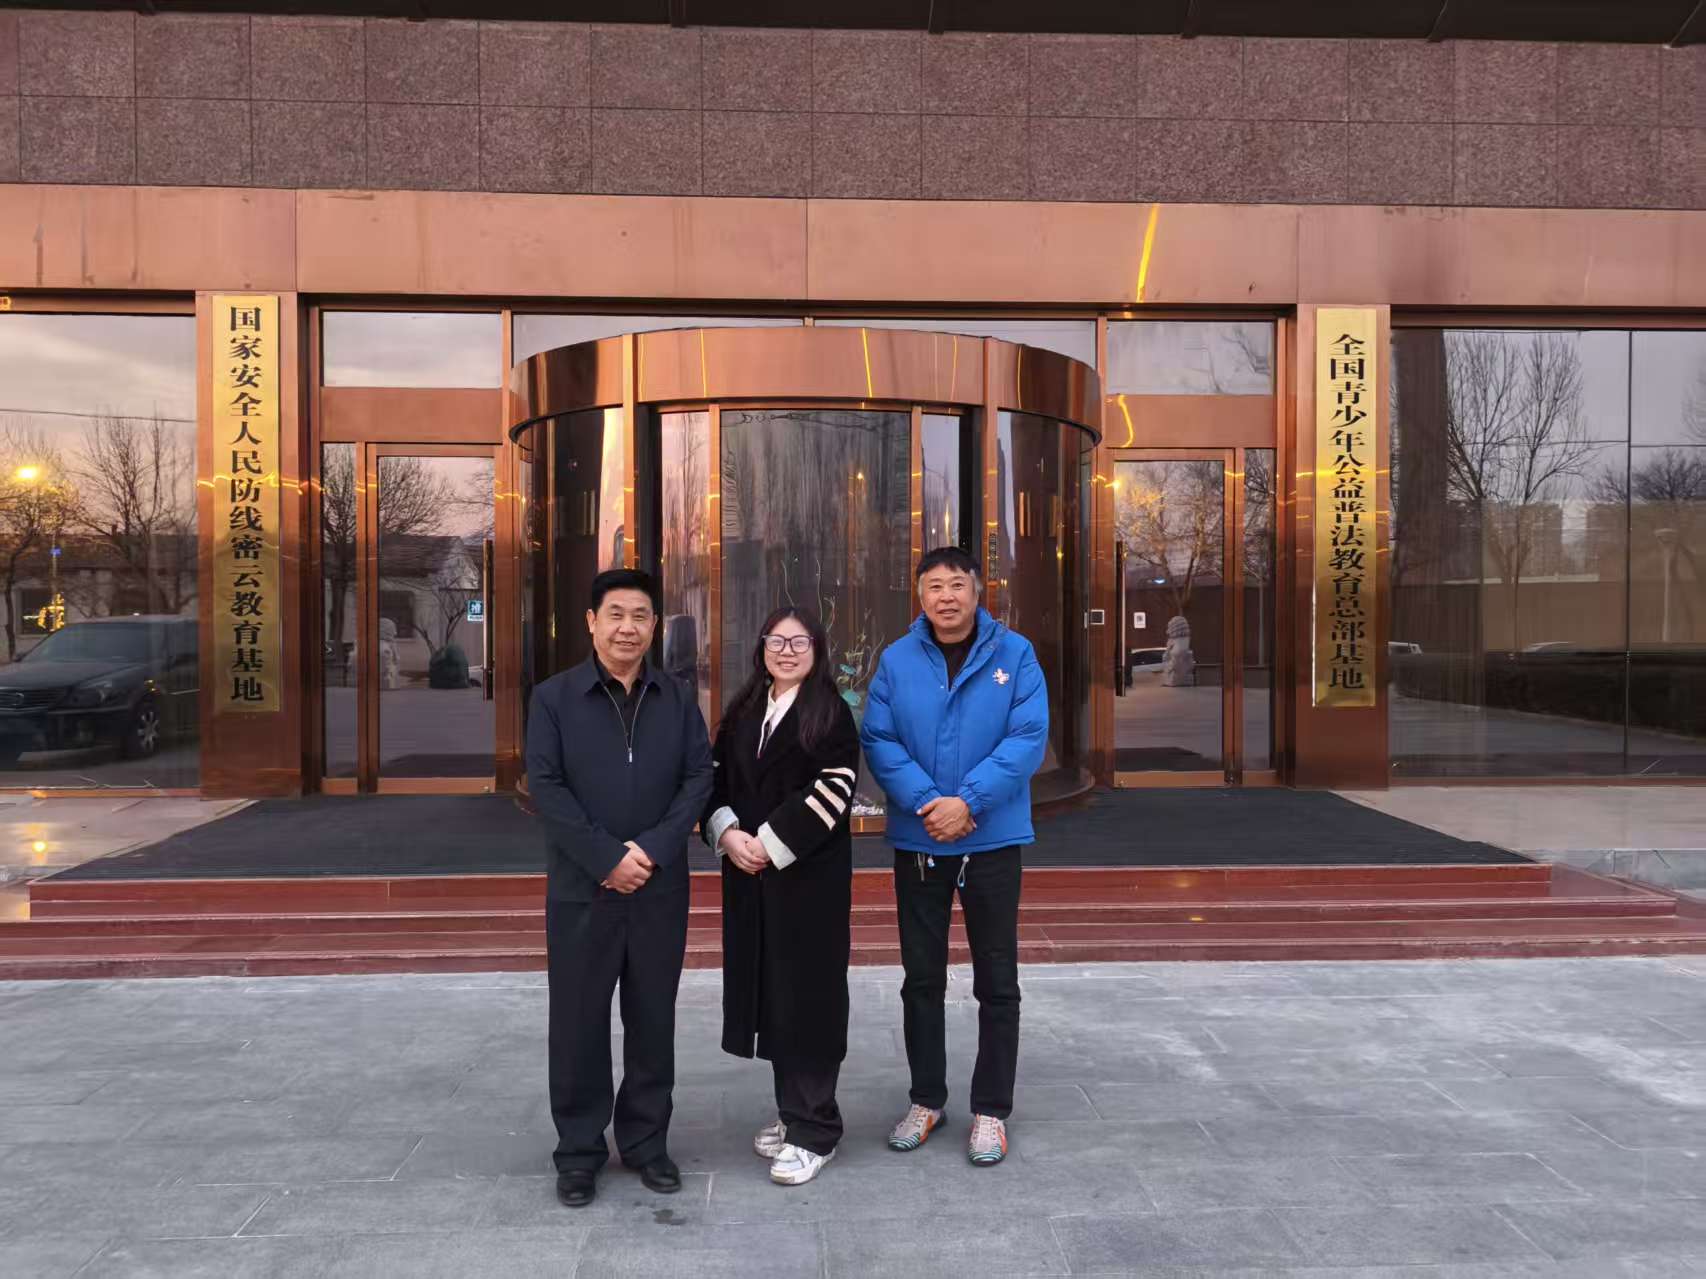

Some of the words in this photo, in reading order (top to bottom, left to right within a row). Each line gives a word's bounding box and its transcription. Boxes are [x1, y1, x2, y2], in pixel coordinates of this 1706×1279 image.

[229, 306, 264, 701] 国家安全人民防线密云教育基地
[1329, 333, 1367, 689] 全国青少年公益普法教育总部基地
